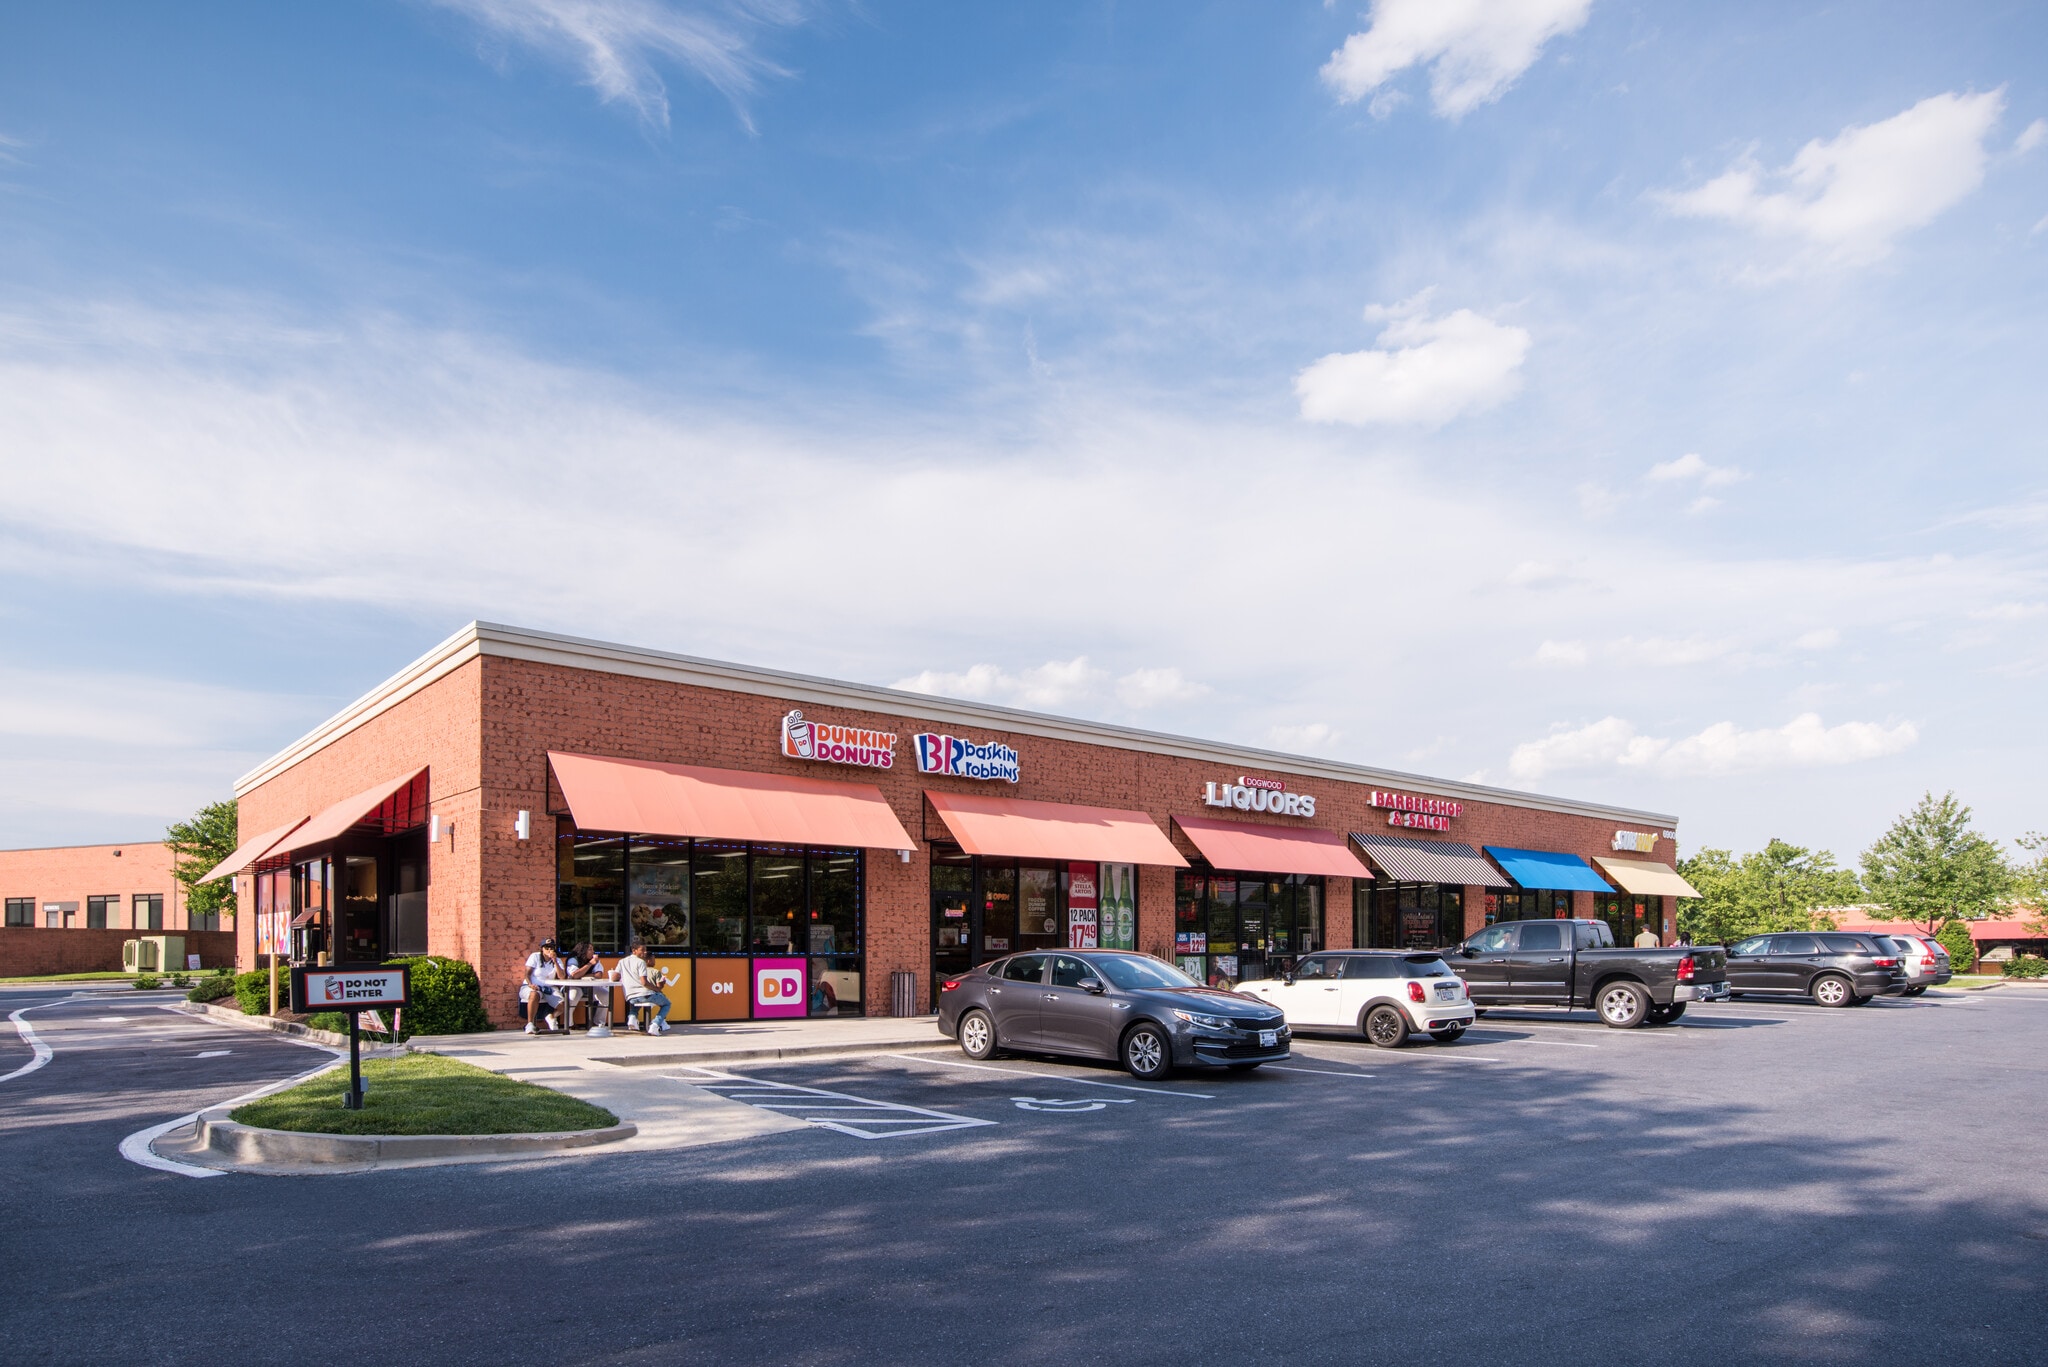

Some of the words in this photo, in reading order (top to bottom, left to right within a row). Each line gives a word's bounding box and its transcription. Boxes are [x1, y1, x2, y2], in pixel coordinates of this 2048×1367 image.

[817, 725, 897, 750] DUNKIN'
[817, 744, 892, 767] DONUTS
[965, 740, 1017, 764] baskin
[965, 762, 1019, 783] robbins
[1246, 778, 1282, 790] DOGWOOD
[1205, 781, 1316, 818] LIQUORS
[1374, 791, 1464, 817] BARBERSHOP
[1392, 810, 1403, 826] &
[1407, 812, 1450, 831] SALON
[1070, 909, 1078, 922] 12
[1079, 909, 1096, 922] PACK
[1185, 961, 1203, 980] IPA
[346, 980, 362, 988] DO
[364, 979, 388, 987] NOT
[346, 989, 383, 998] ENTER
[711, 981, 734, 995] ON
[763, 977, 798, 998] DD
